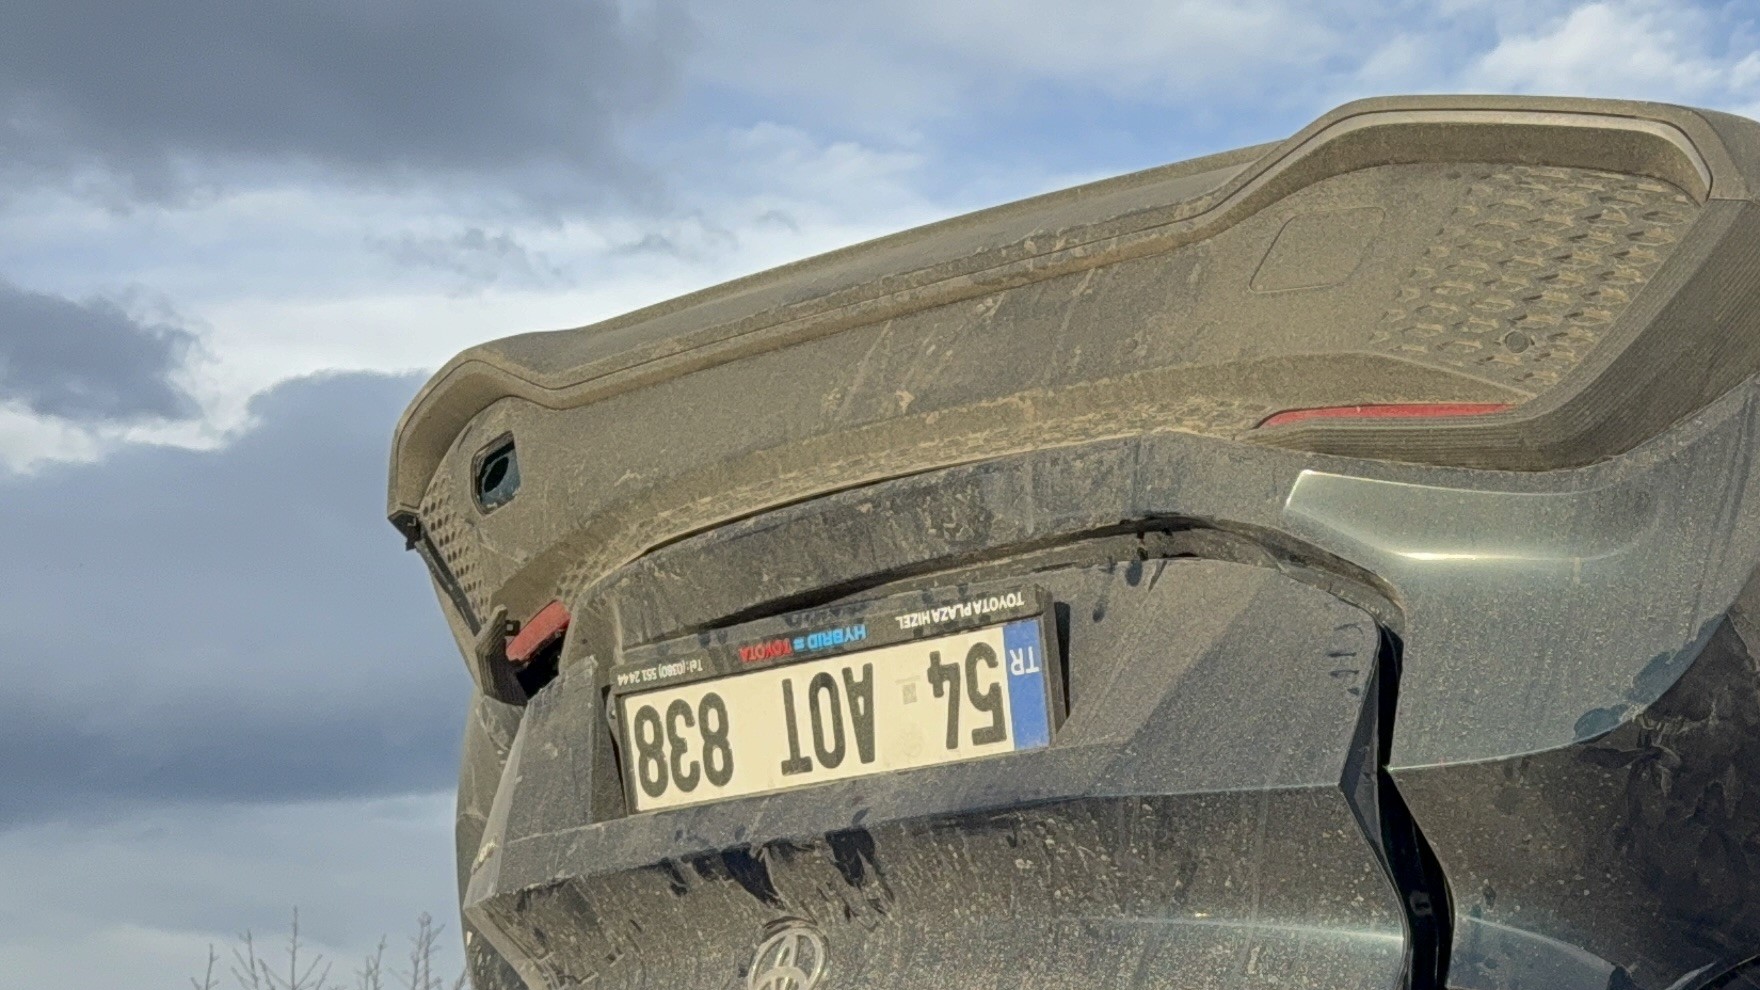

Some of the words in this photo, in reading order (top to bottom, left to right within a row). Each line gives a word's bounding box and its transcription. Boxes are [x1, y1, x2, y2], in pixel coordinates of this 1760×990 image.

[931, 601, 972, 622] PLAZA
[973, 591, 1024, 613] TOYOTA
[895, 609, 931, 630] HIZEL
[740, 638, 791, 662] TOYOTA
[807, 624, 867, 650] HYBRID
[1010, 645, 1039, 676] TR
[927, 641, 1008, 750] 54
[780, 663, 875, 776] AOT
[633, 691, 734, 798] 838
